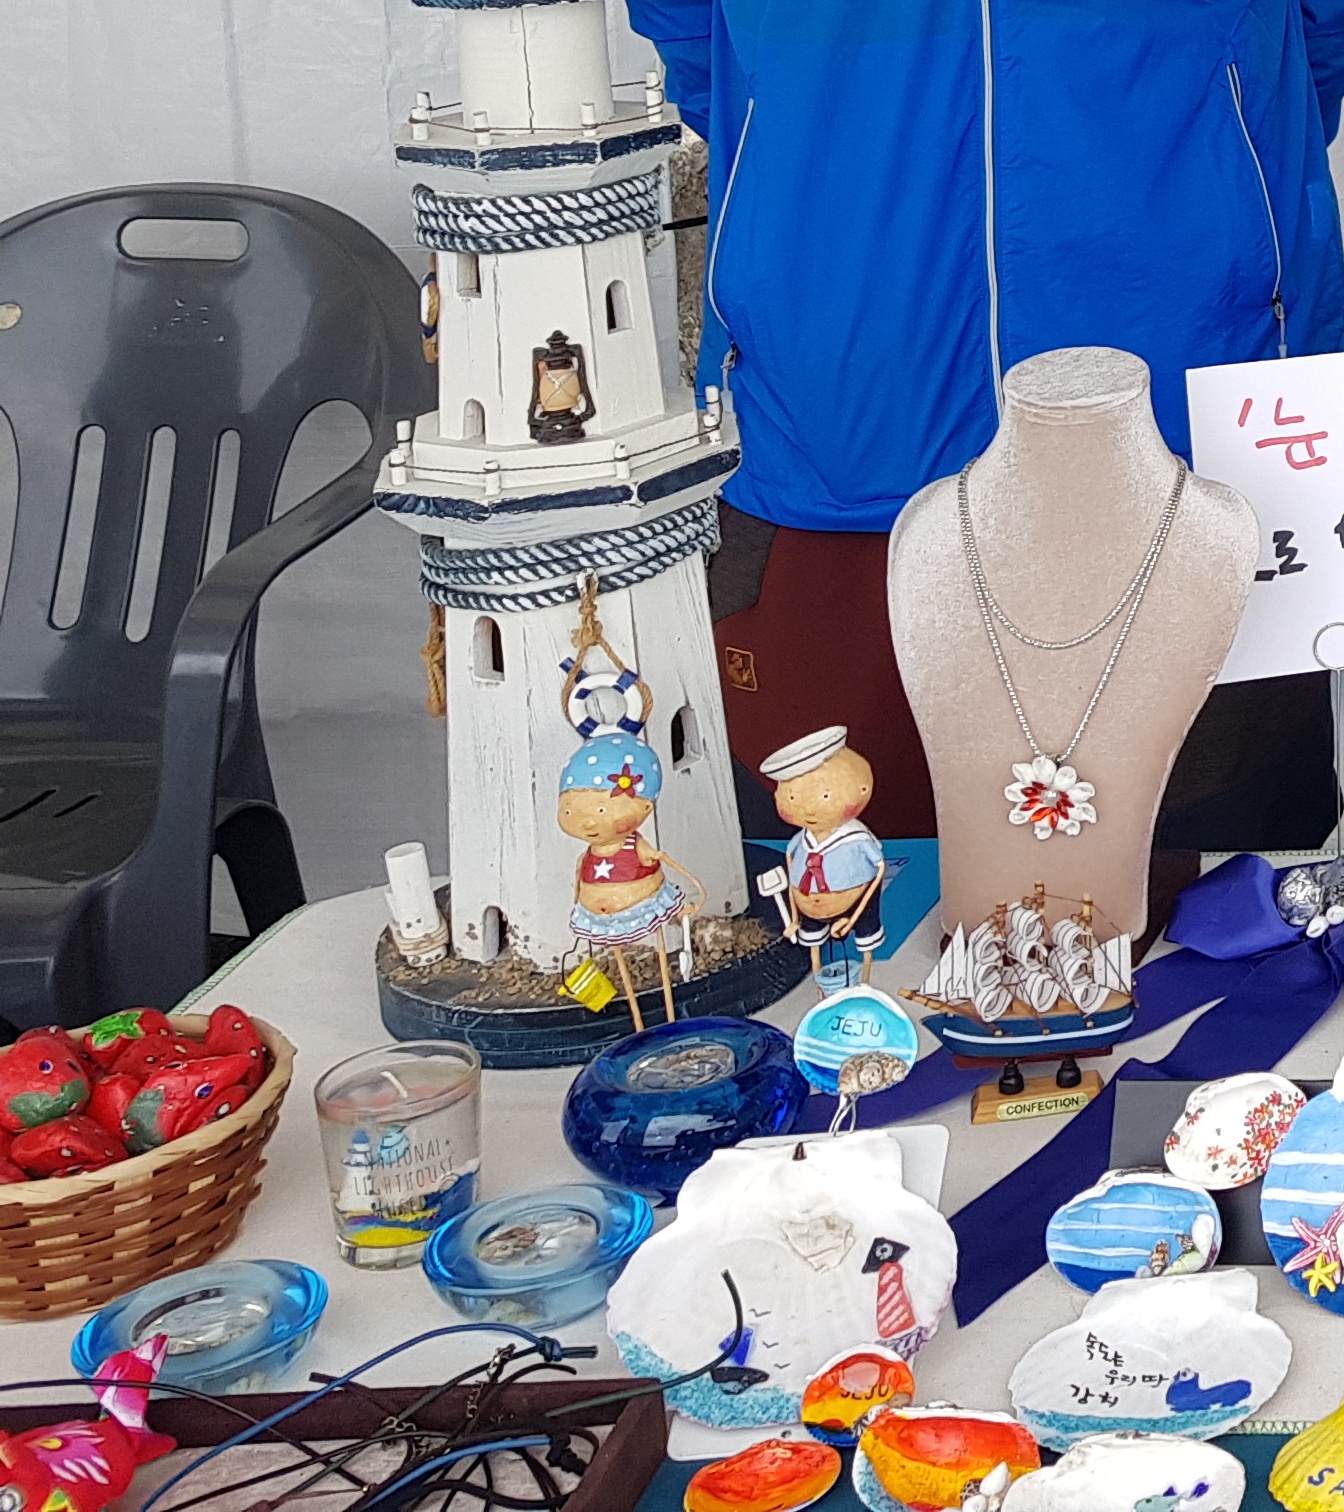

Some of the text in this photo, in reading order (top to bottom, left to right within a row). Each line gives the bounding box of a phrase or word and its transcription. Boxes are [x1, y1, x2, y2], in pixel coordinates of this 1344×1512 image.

[830, 1014, 884, 1040] JEJU
[1005, 1096, 1080, 1117] CONFECTION
[1104, 1369, 1138, 1387] 우리
